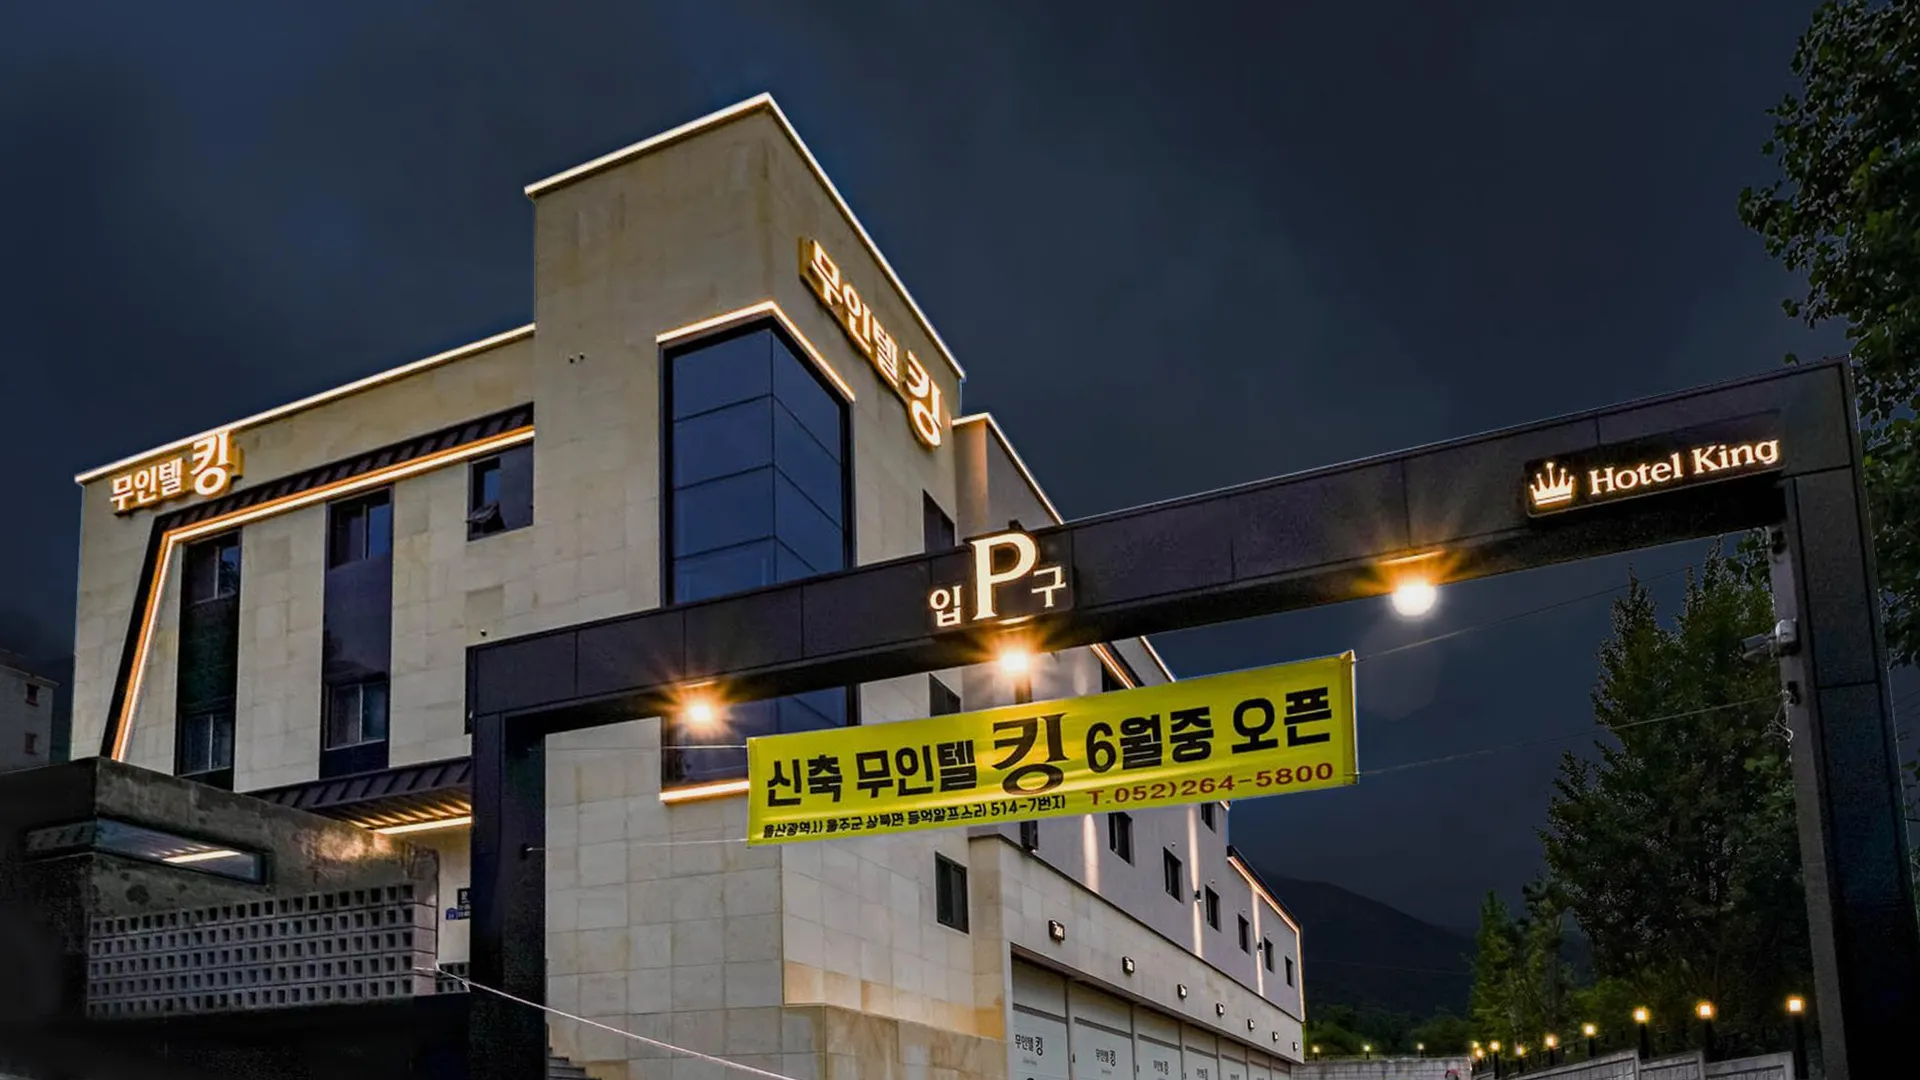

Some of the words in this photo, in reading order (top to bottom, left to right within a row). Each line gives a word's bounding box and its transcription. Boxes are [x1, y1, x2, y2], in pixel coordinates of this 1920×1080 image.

[811, 239, 899, 388] 무인텔
[905, 350, 942, 446] 킹
[109, 458, 183, 511] 무인텔
[190, 430, 231, 496] 킹
[1588, 452, 1684, 495] Hotel
[1691, 439, 1779, 475] King
[929, 585, 963, 627] 입
[970, 533, 1037, 621] P
[1031, 566, 1067, 608] 구
[767, 754, 843, 807] 신축
[855, 740, 977, 798] 무인텔
[991, 712, 1069, 796] 킹
[1087, 706, 1214, 773] 6월중
[1231, 687, 1332, 754] 오픈
[763, 820, 823, 838] 울산광역시
[908, 804, 987, 825] 등억알프스리
[991, 795, 1066, 816] 514-7번지
